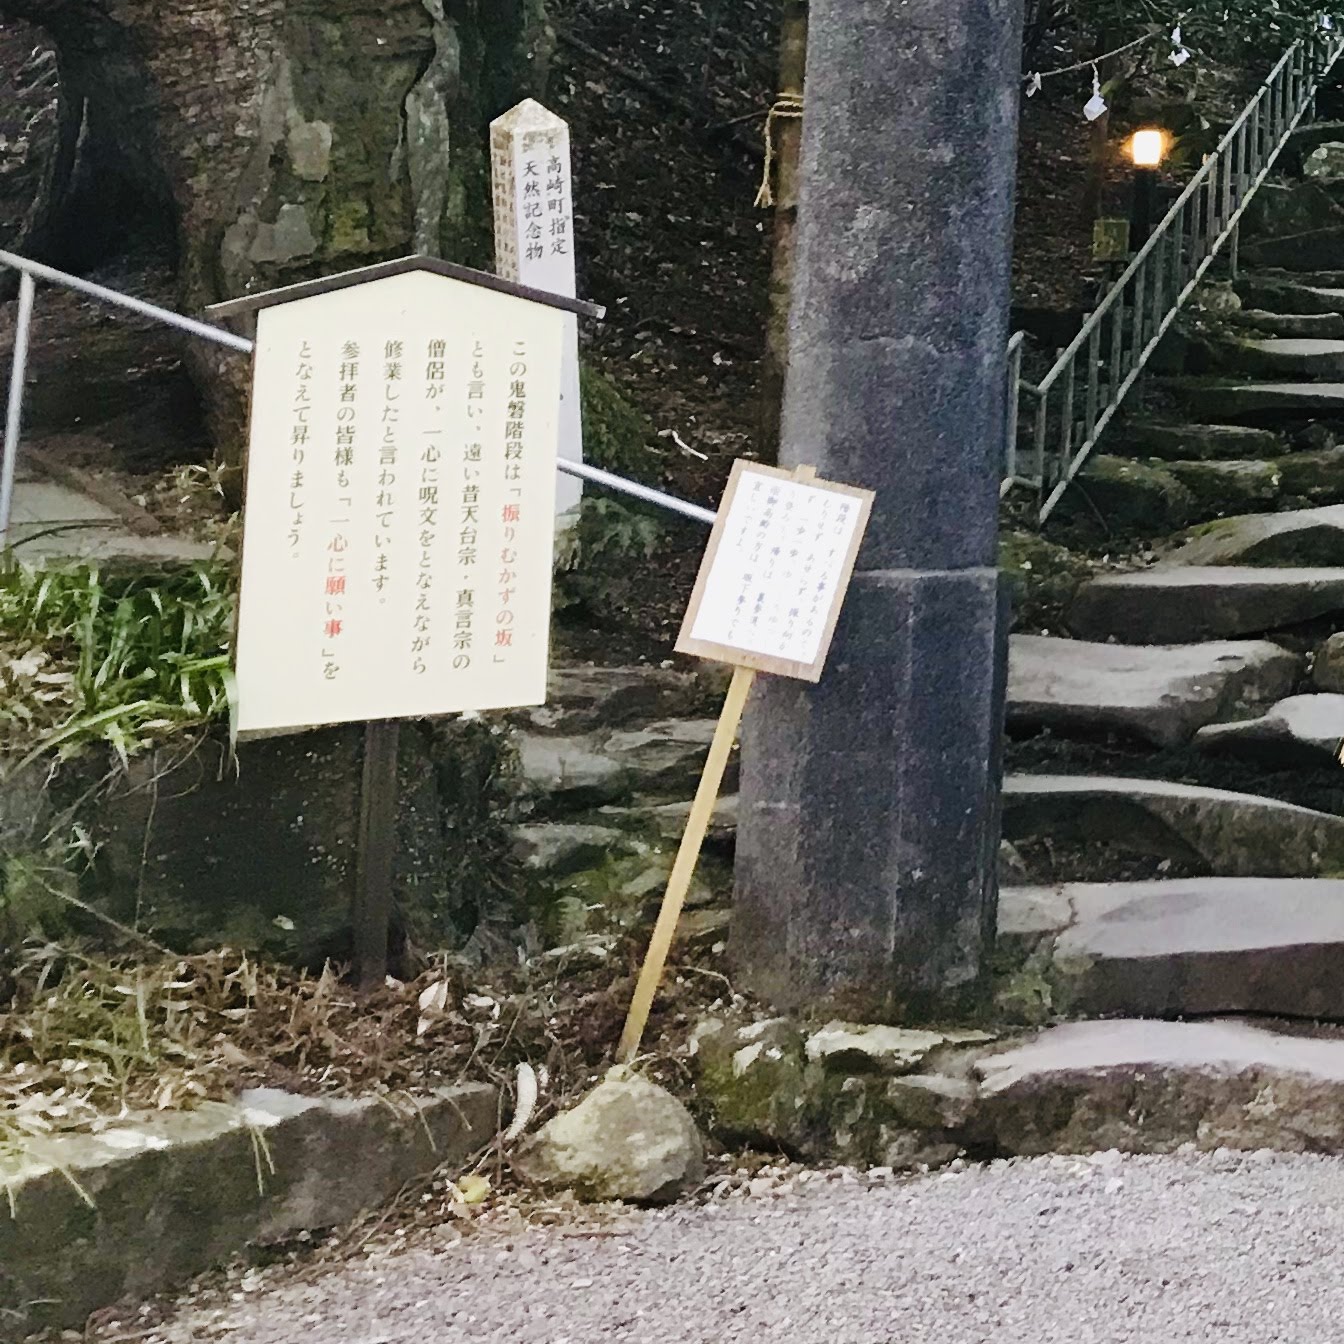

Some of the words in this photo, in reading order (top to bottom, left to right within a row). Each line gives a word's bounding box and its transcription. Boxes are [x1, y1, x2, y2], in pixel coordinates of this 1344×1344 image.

[522, 160, 543, 261] 天然記念物
[546, 155, 569, 256] 高崎町指定
[287, 340, 313, 559] となえて昇りましょう。
[321, 340, 361, 680] 参拝者の皆様も「一心に願い事」を
[372, 340, 403, 605] 修業したと言われています。
[411, 340, 446, 674] 僧侶が、一心に呪文をとなえながら
[452, 340, 485, 670] とも言い、遠い昔天台宗・真言宗の
[493, 340, 528, 665] この鬼磐階段は「振りむかずの坂」
